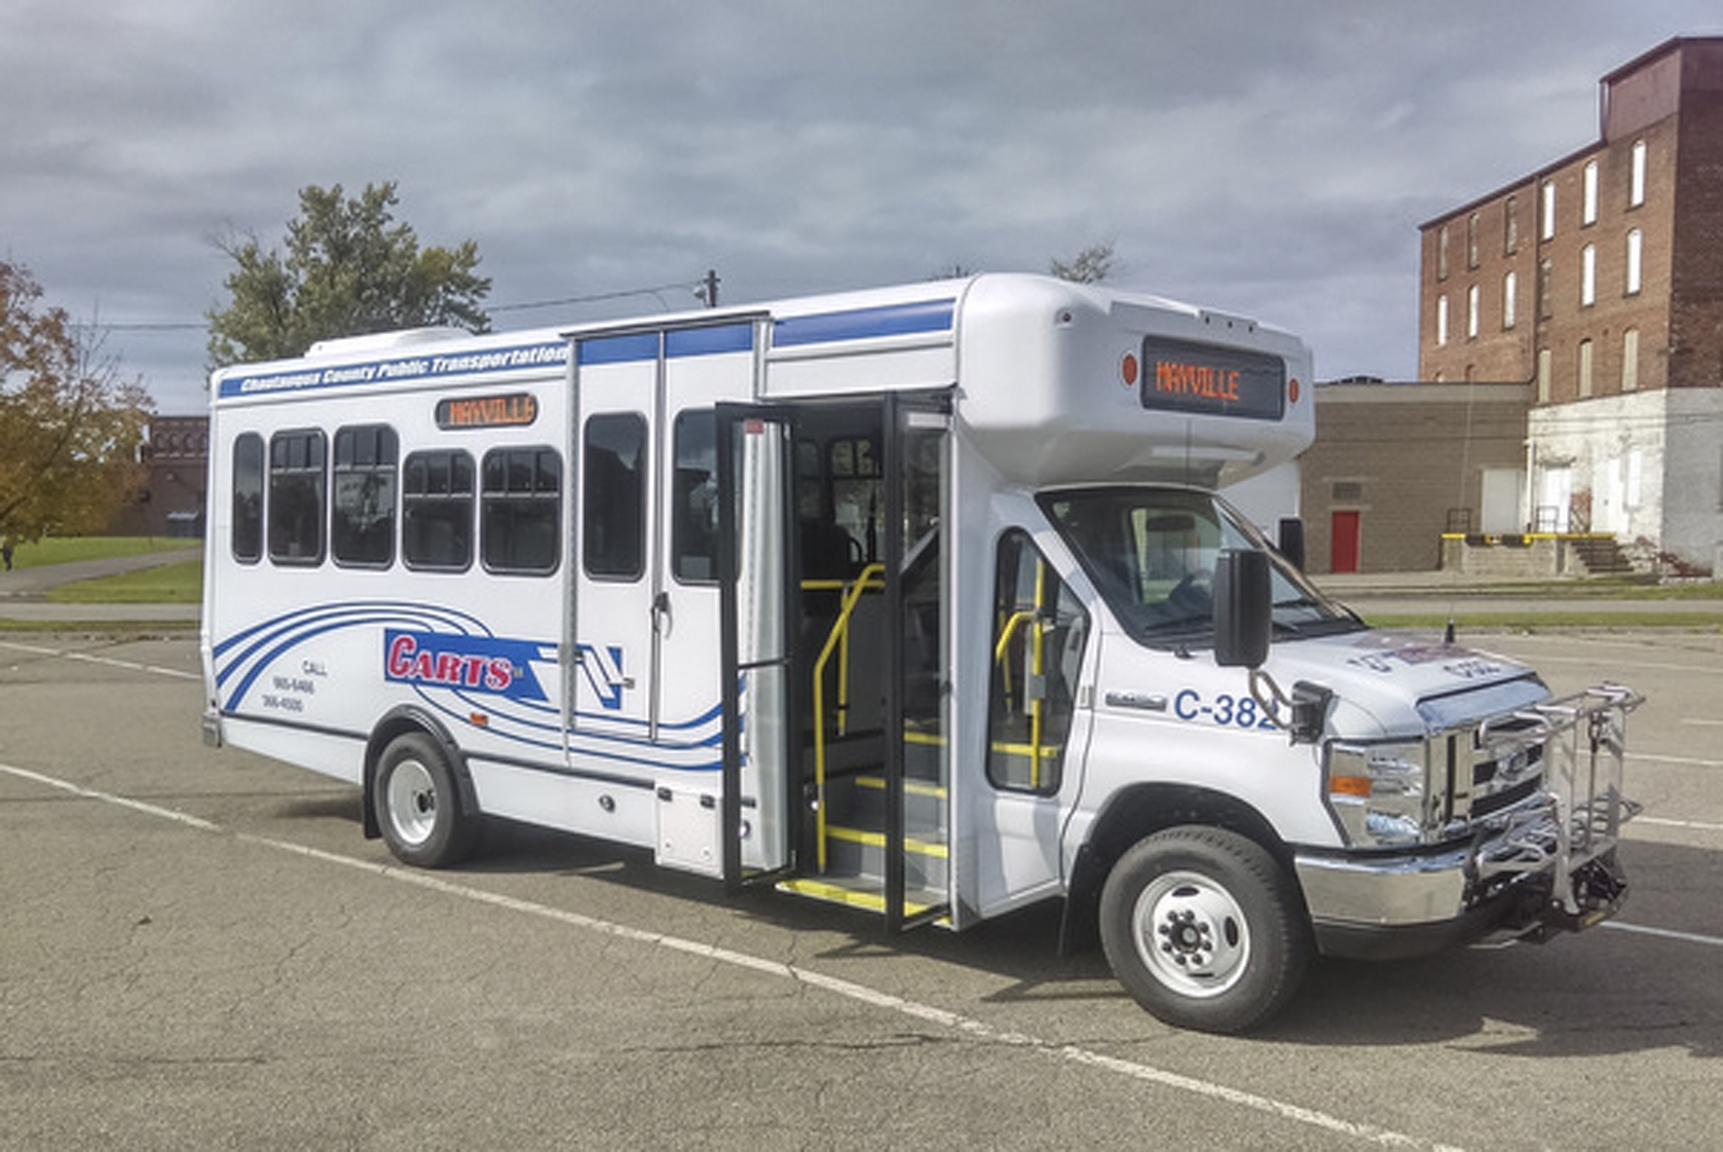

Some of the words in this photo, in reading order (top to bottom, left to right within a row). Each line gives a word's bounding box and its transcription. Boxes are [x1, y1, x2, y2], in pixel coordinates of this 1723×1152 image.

[322, 366, 376, 384] County
[377, 359, 429, 379] Public
[432, 346, 568, 373] Transportation
[1156, 361, 1240, 401] MAYVILLE
[449, 396, 535, 425] MAYVILLE
[301, 660, 328, 677] CALL
[1174, 689, 1279, 730] C-382
